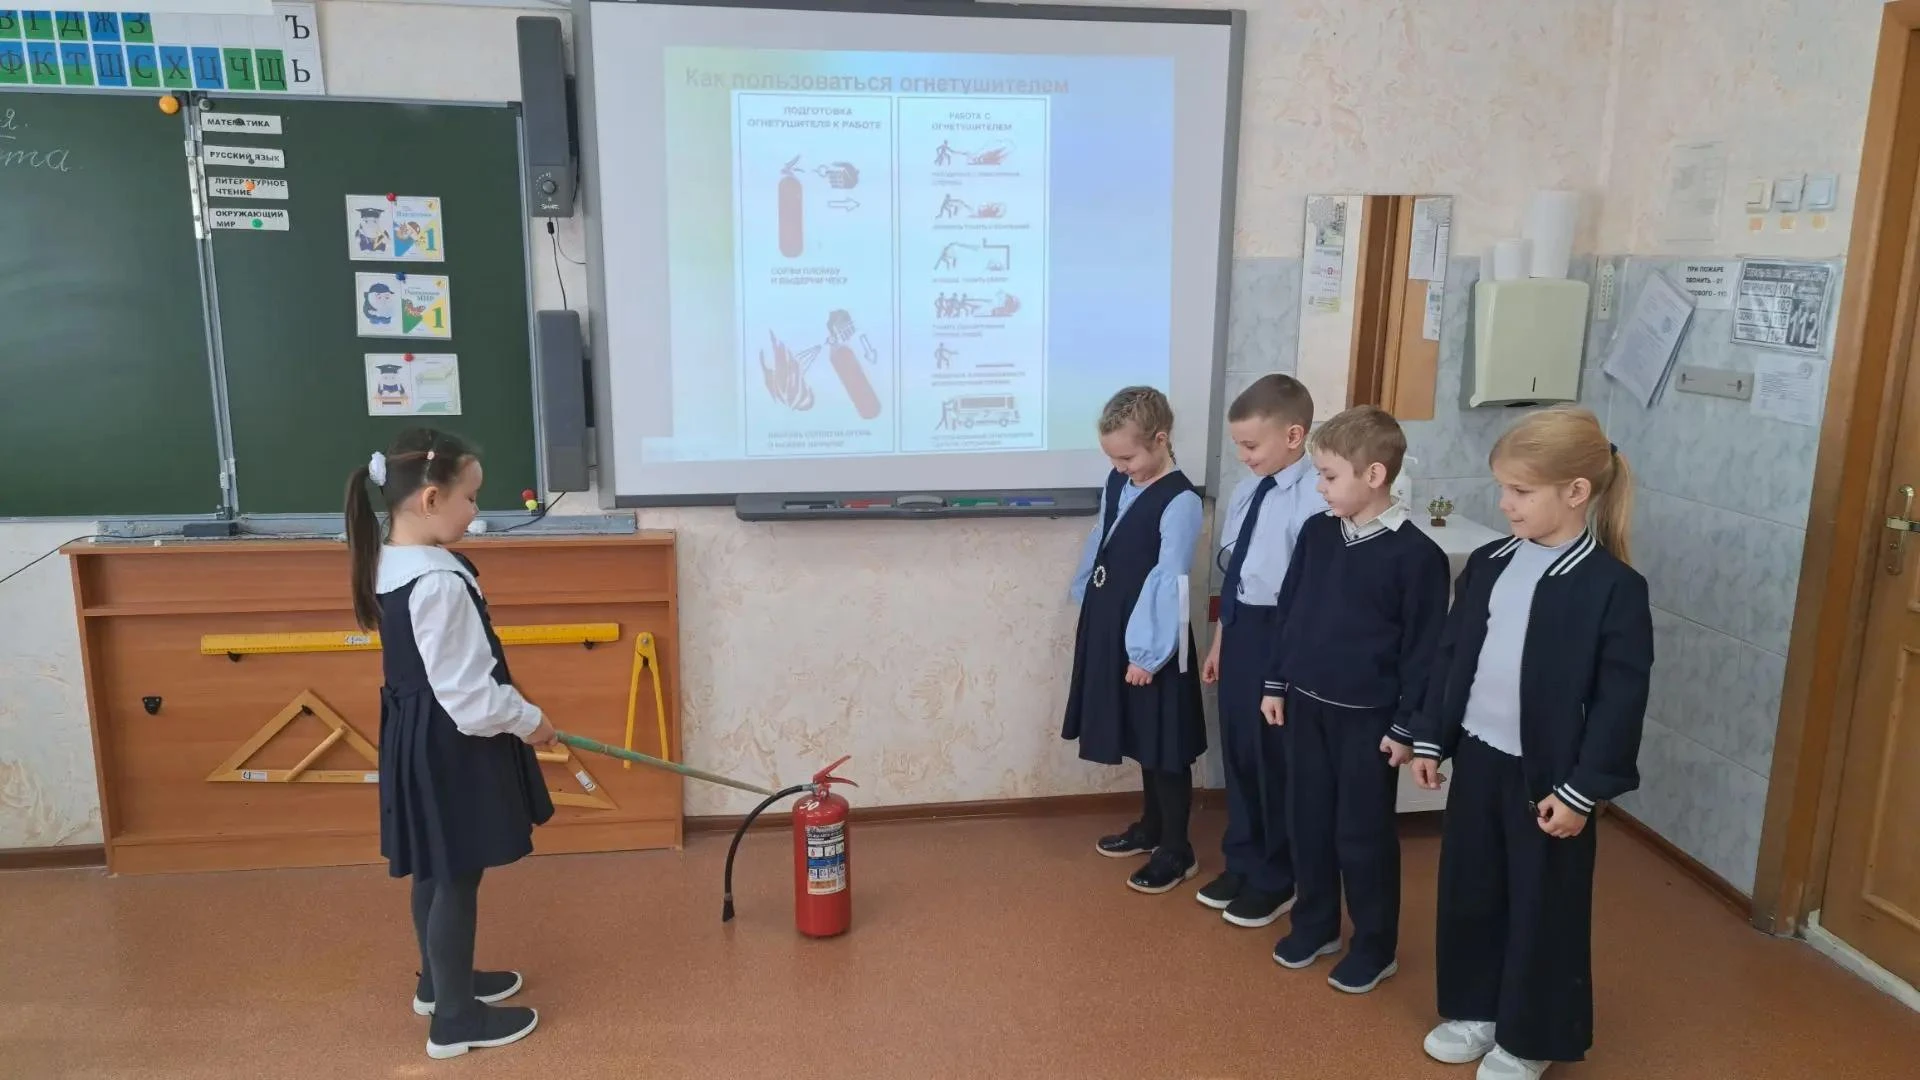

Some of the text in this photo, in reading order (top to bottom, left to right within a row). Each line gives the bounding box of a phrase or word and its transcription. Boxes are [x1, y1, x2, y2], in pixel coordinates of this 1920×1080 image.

[285, 14, 310, 39] Ъ
[0, 50, 311, 90] Ф К Т Ш С Х Ц Ч Щ Ь
[685, 67, 1069, 96] Как пользоваться огнетушителем
[783, 106, 853, 116] ПОДГОТОВКА
[747, 118, 831, 128] ОГНЕТУШИТЕЛЯ
[842, 120, 881, 129] РАБОТЕ
[209, 151, 280, 162] РУССКИЙ ЯЗЫК
[215, 188, 252, 196] ЧТЕНИЕ
[215, 210, 284, 218] ОКРУЖАЮЩИЙ
[426, 227, 437, 251] 1
[432, 306, 444, 328] 1
[1789, 311, 1818, 345] 112
